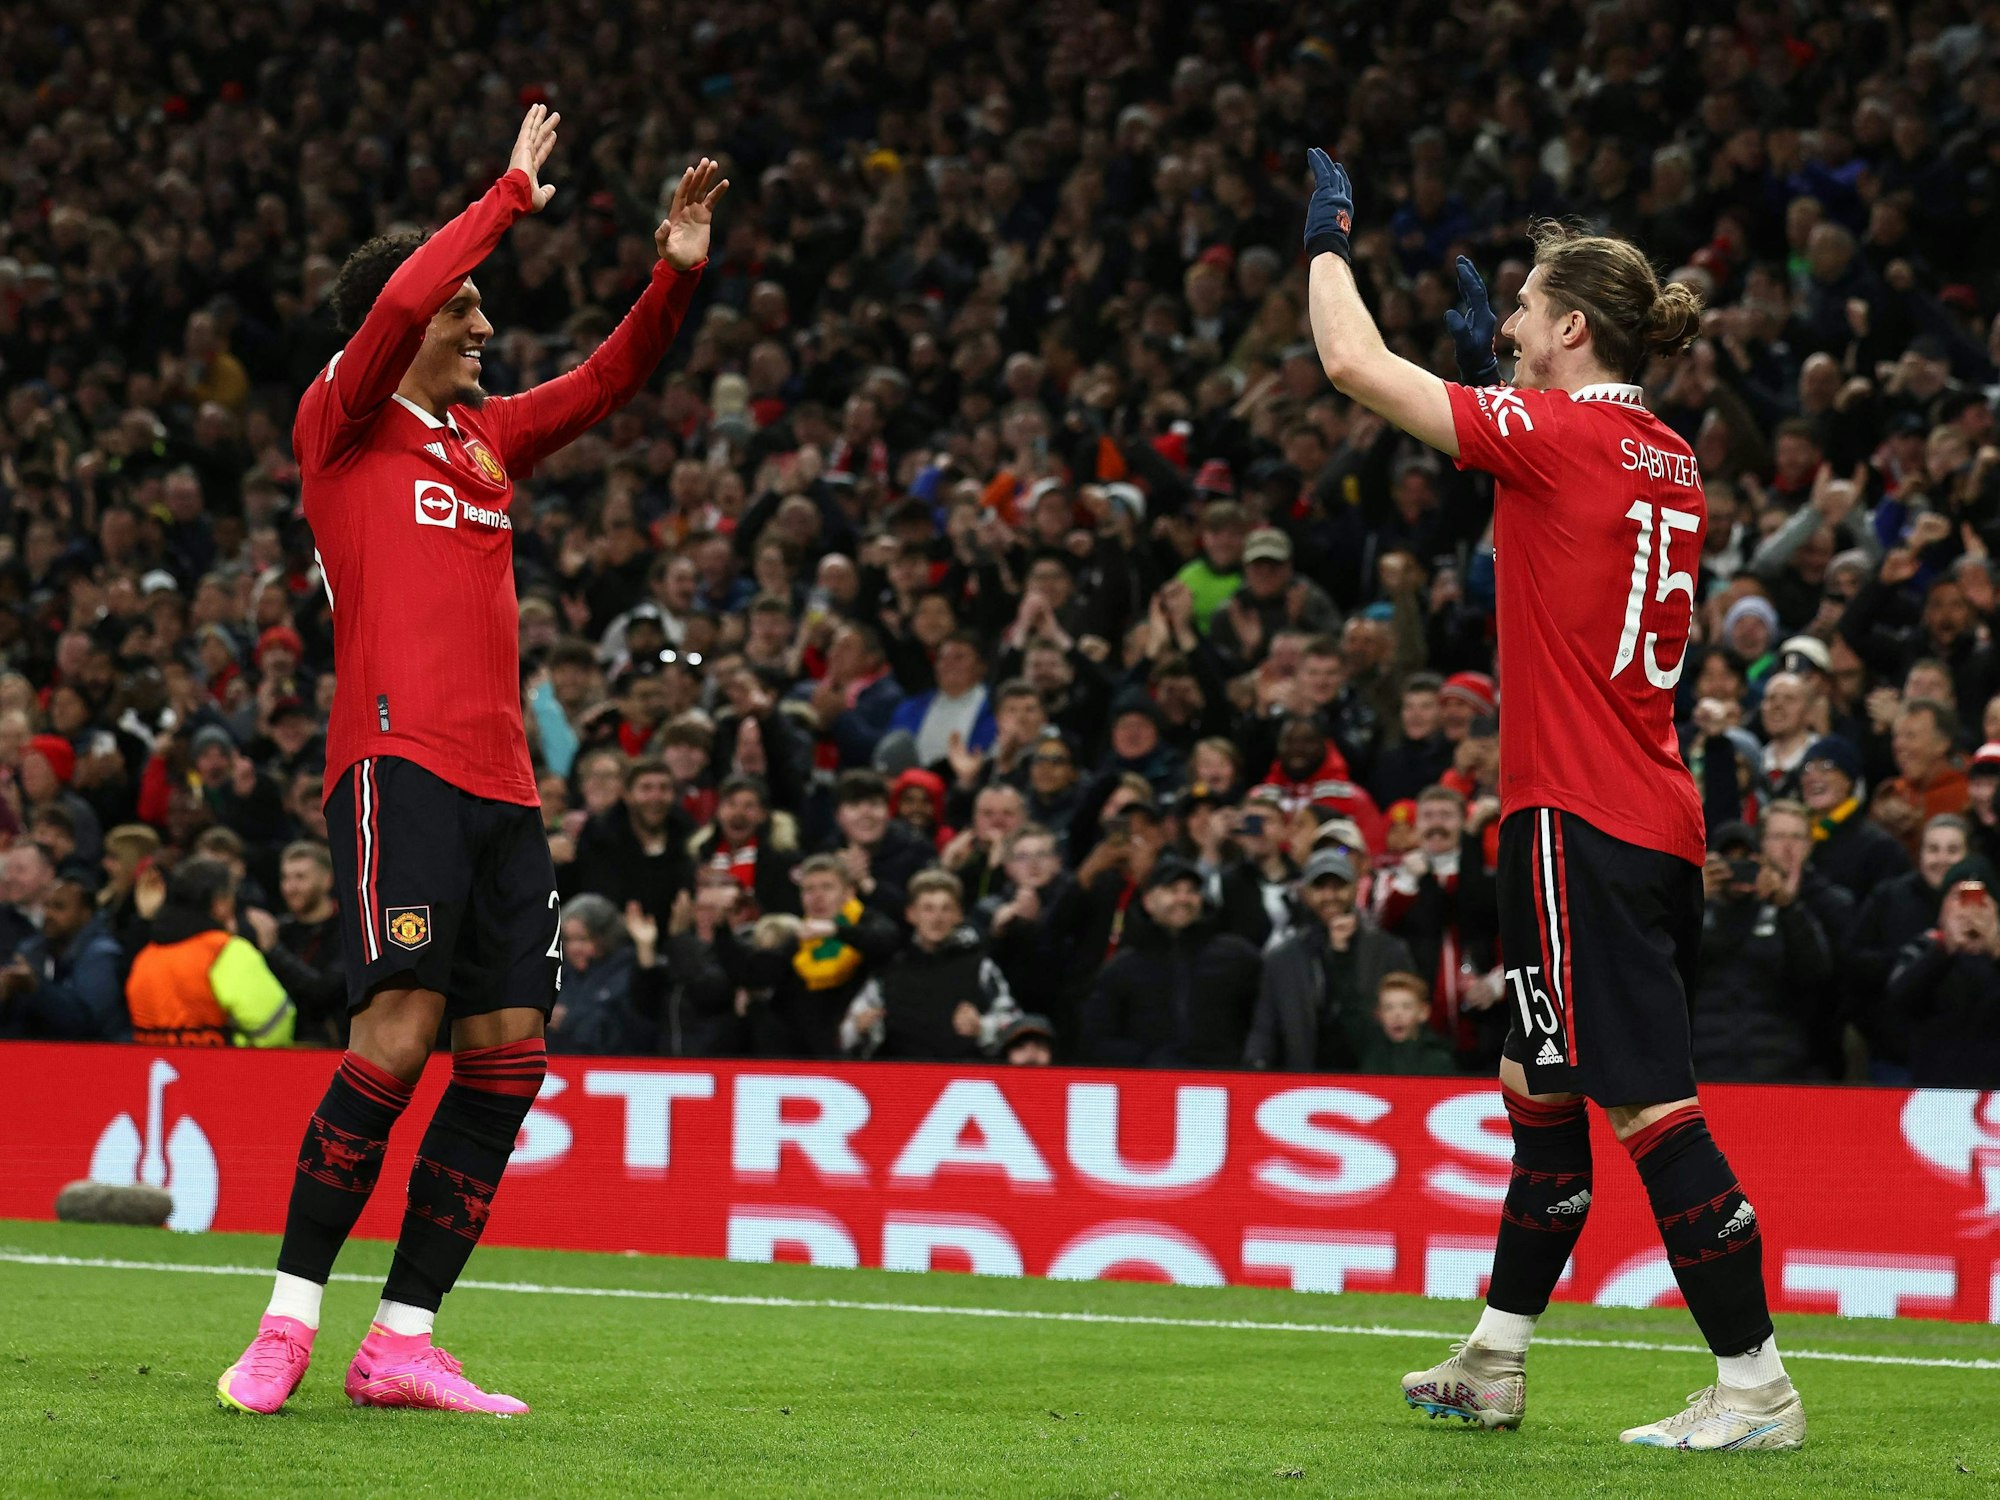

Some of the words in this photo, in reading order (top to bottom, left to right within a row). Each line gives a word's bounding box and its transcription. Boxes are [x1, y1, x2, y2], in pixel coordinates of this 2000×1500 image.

[1483, 385, 1534, 437] XC
[1620, 438, 1702, 492] SABITZER
[1609, 499, 1700, 690] 15
[545, 889, 564, 963] 2
[1504, 965, 1559, 1038] 15
[1535, 1054, 1564, 1066] adidas
